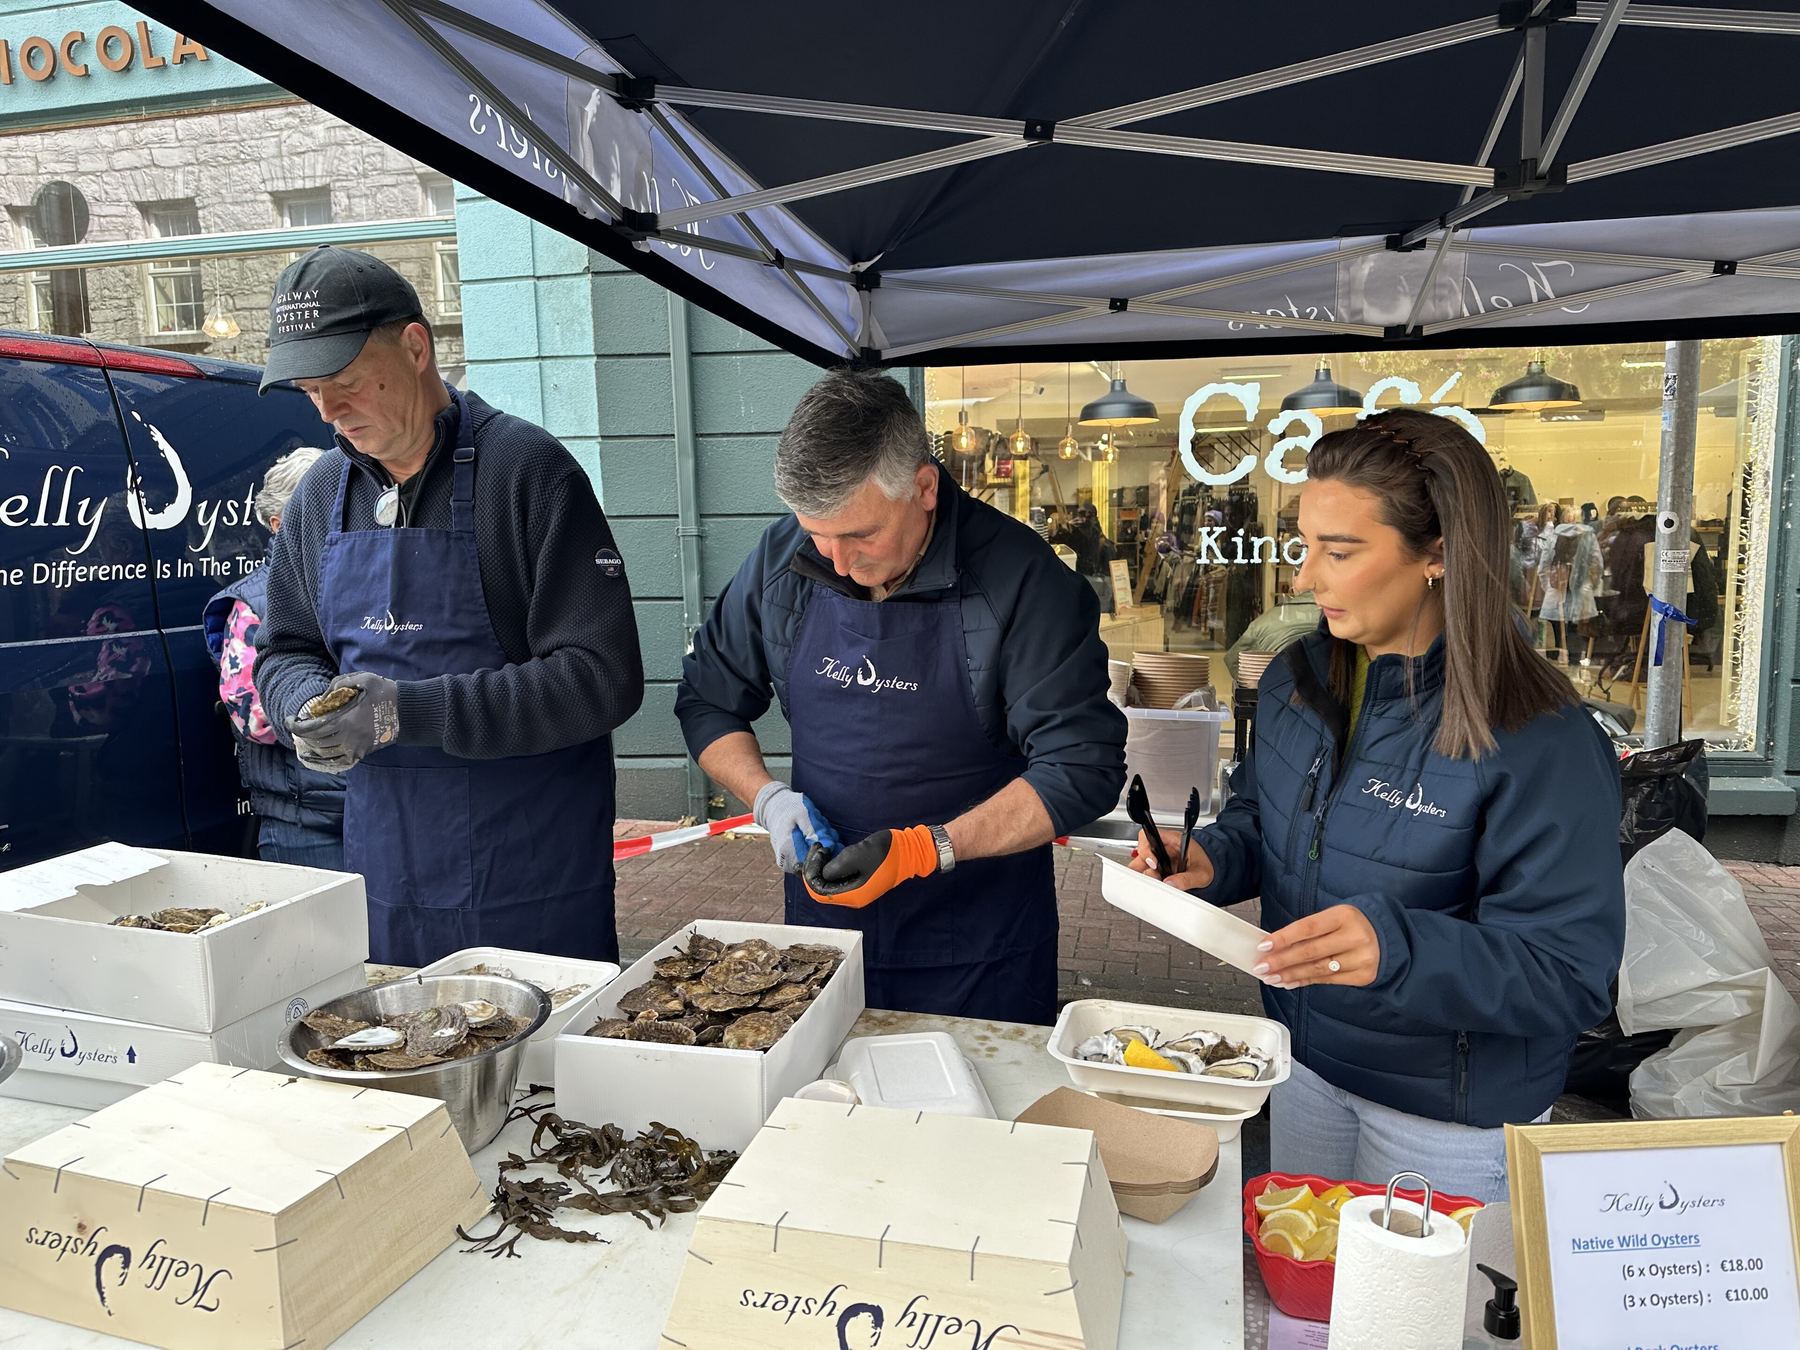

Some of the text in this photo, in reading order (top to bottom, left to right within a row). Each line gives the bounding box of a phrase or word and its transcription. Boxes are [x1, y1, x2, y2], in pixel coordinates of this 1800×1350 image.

[0, 20, 208, 85] OCOLA
[276, 301, 320, 313] INTERNATIONAL
[277, 290, 319, 304] GALWAY
[276, 310, 320, 323] OYSTER
[278, 322, 316, 334] FESTIVAL
[0, 410, 267, 555] elly Oyst
[33, 559, 147, 588] Difference
[156, 559, 171, 579] Is
[177, 559, 194, 578] In
[199, 557, 231, 576] The
[360, 616, 385, 635] Kelly
[815, 654, 919, 693] Kelly Oysters
[1361, 778, 1447, 818] Kelly Oysters
[15, 1025, 118, 1066] Kelly Oysters
[1599, 1180, 1726, 1217] Kelly Oysters
[1571, 1232, 1700, 1251] Native Wild Oysters
[25, 1226, 233, 1316] Kelly Oysters
[1622, 1264, 1635, 1281] (6
[1638, 1267, 1646, 1277] x
[1648, 1260, 1702, 1279] Oysters)
[1720, 1257, 1764, 1272] €18.00
[1623, 1294, 1636, 1311] (3
[1639, 1297, 1647, 1307] x
[1650, 1290, 1704, 1309] Oysters)
[1725, 1287, 1769, 1302] €10.00
